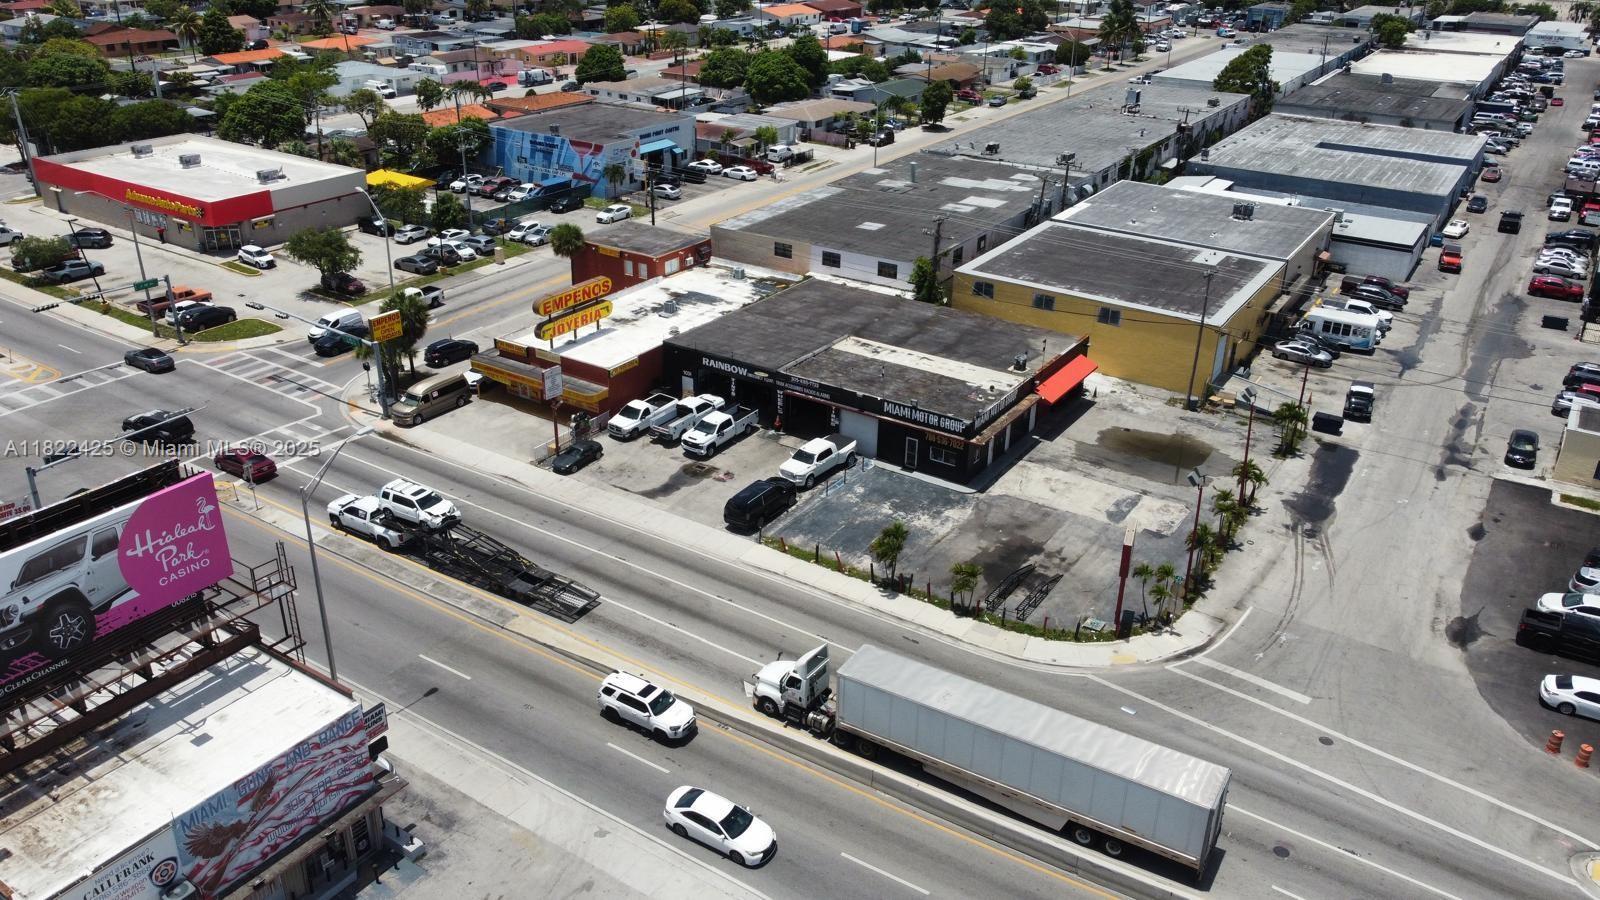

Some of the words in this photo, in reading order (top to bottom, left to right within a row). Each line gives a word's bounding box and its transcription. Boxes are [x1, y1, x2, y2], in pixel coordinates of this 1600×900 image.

[702, 357, 748, 376] RAINBOW
[883, 402, 911, 418] MIAMI
[911, 409, 939, 426] MOTOR
[939, 417, 966, 433] GROUP
[126, 516, 215, 557] Hialeah
[159, 558, 210, 586] CASINO
[181, 794, 227, 833] MIAMI
[238, 764, 273, 798] GUNS
[285, 741, 311, 769] AND
[319, 709, 361, 746] RANGE
[114, 851, 155, 882] FRANK
